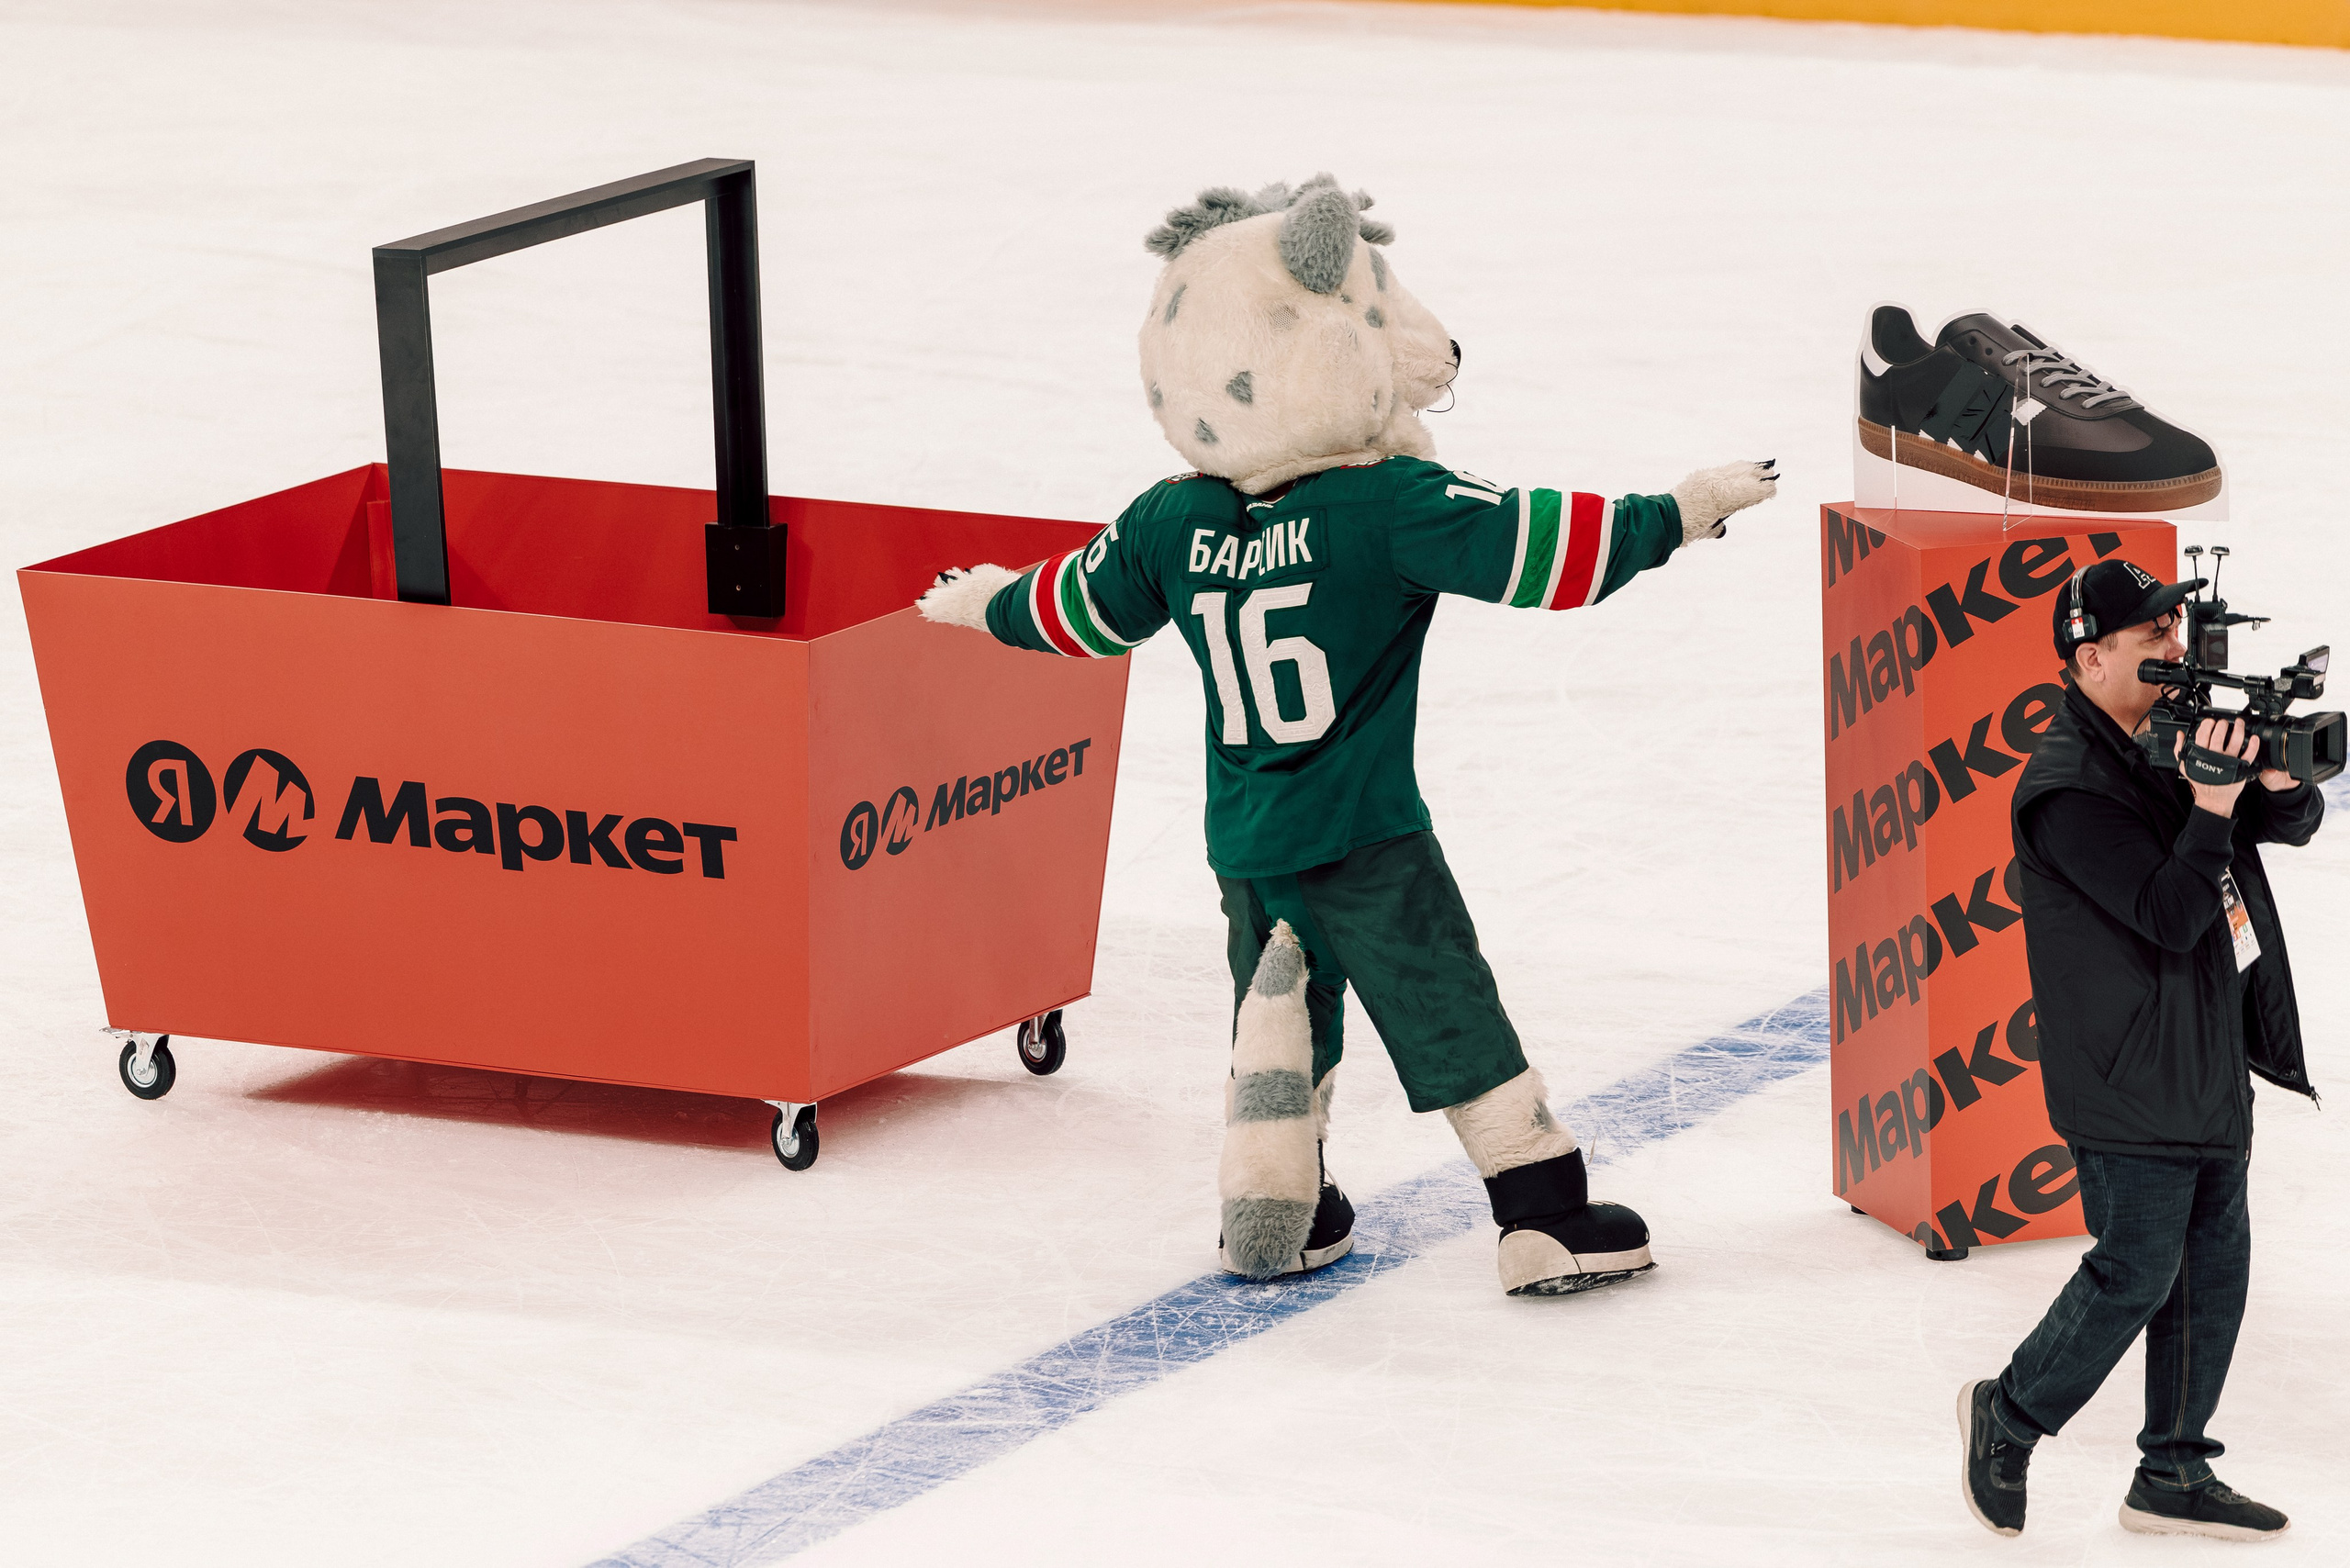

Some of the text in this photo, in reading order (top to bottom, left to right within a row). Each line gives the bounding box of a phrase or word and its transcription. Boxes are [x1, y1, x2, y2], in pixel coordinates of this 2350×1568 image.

[1191, 582, 1337, 745] 16
[335, 776, 738, 879] Маркет
[924, 737, 1091, 833] Маркет
[1833, 668, 2073, 894] Марке
[2195, 759, 2223, 775] SONY
[1836, 855, 2024, 1045] Марк
